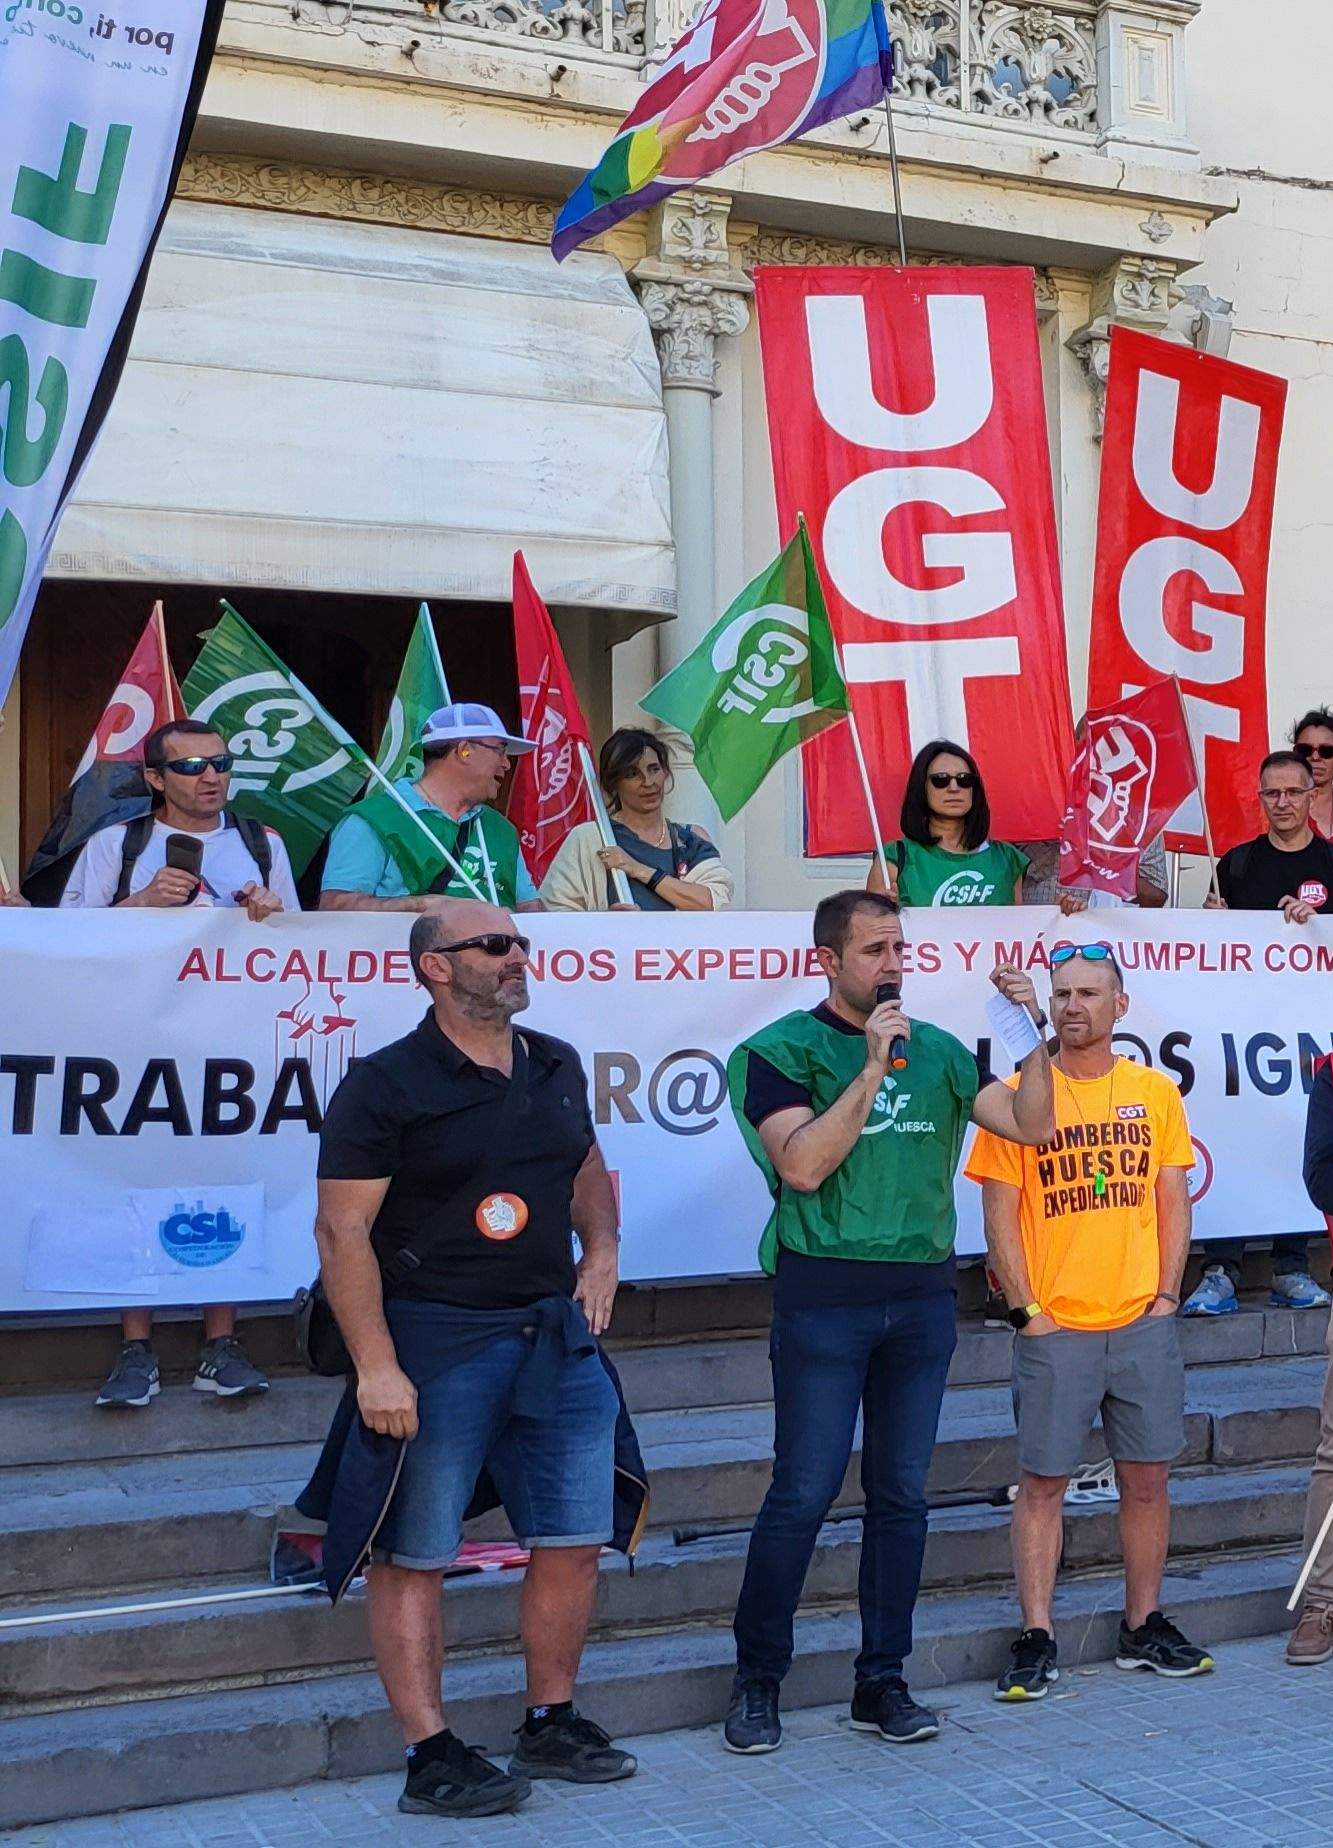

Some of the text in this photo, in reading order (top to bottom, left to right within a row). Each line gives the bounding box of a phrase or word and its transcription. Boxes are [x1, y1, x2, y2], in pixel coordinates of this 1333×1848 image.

[804, 294, 1021, 757] UGT
[1116, 368, 1262, 836] UGT
[953, 941, 981, 972] Y
[1117, 1105, 1145, 1119] CGT
[1038, 1149, 1150, 1188] HUESCA
[164, 1211, 242, 1246] CSL
